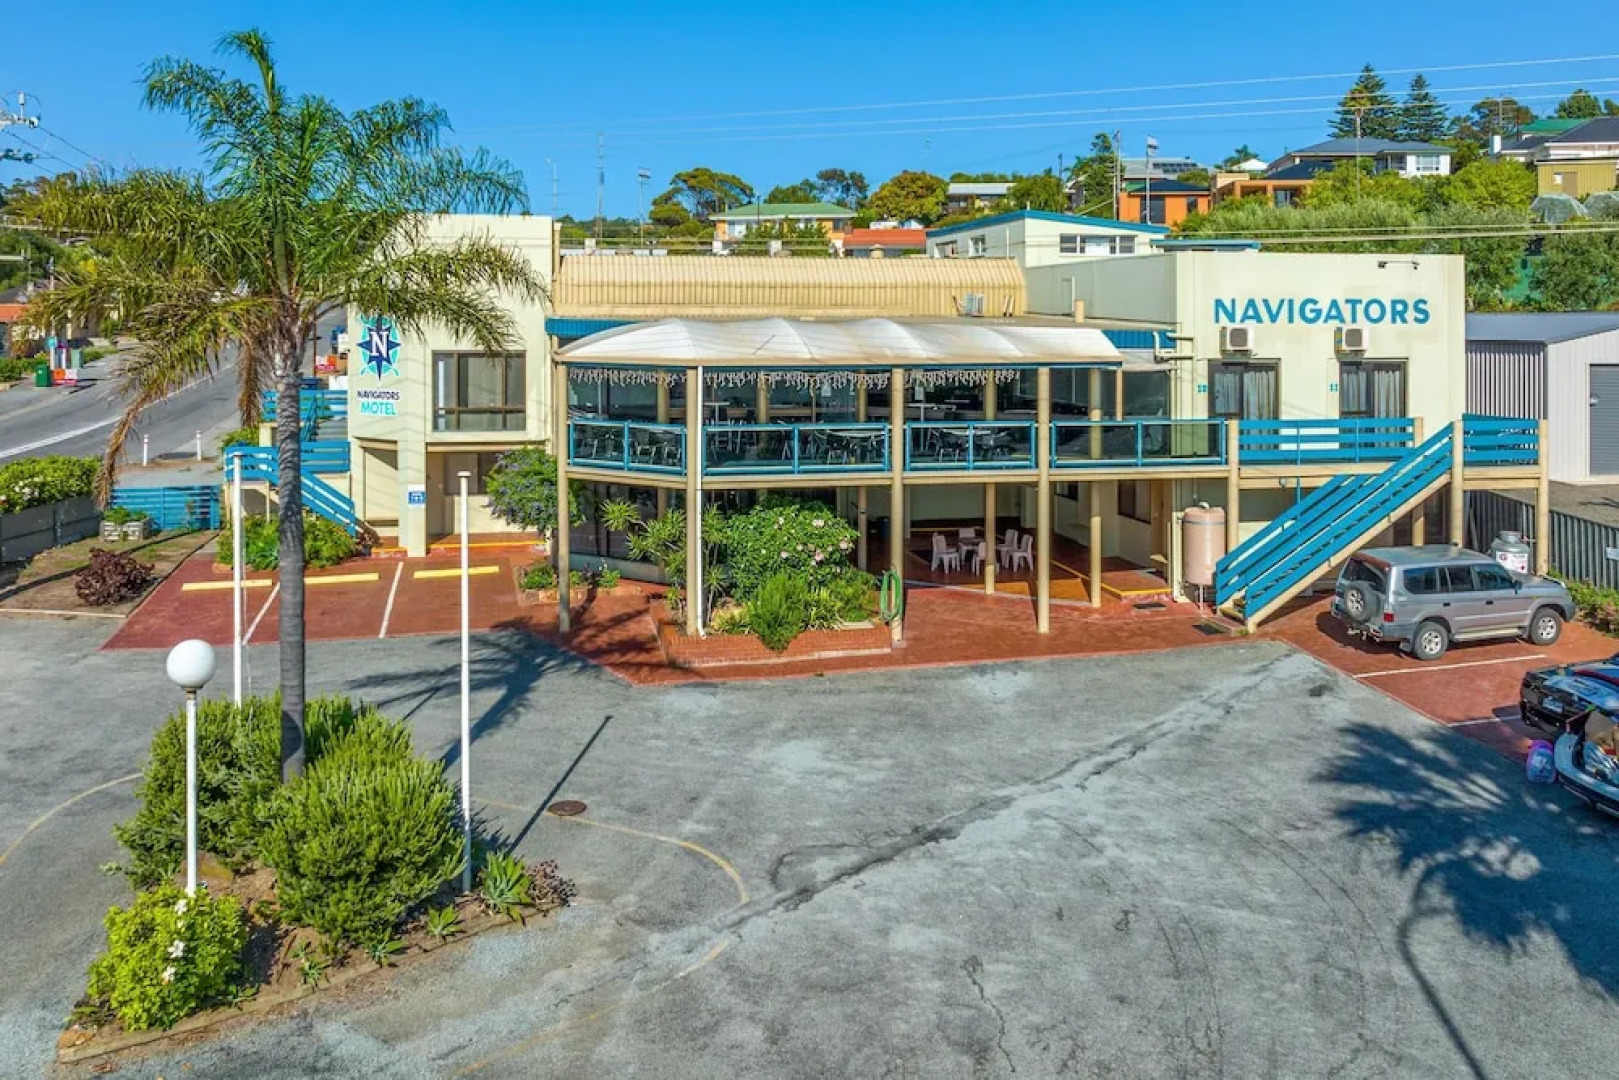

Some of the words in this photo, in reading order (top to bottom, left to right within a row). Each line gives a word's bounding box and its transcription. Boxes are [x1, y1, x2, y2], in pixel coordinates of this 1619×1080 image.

[1214, 298, 1430, 324] NAVIGATORS
[370, 331, 389, 358] N
[357, 390, 400, 400] NAVIGATORS
[361, 402, 396, 415] MOTEL
